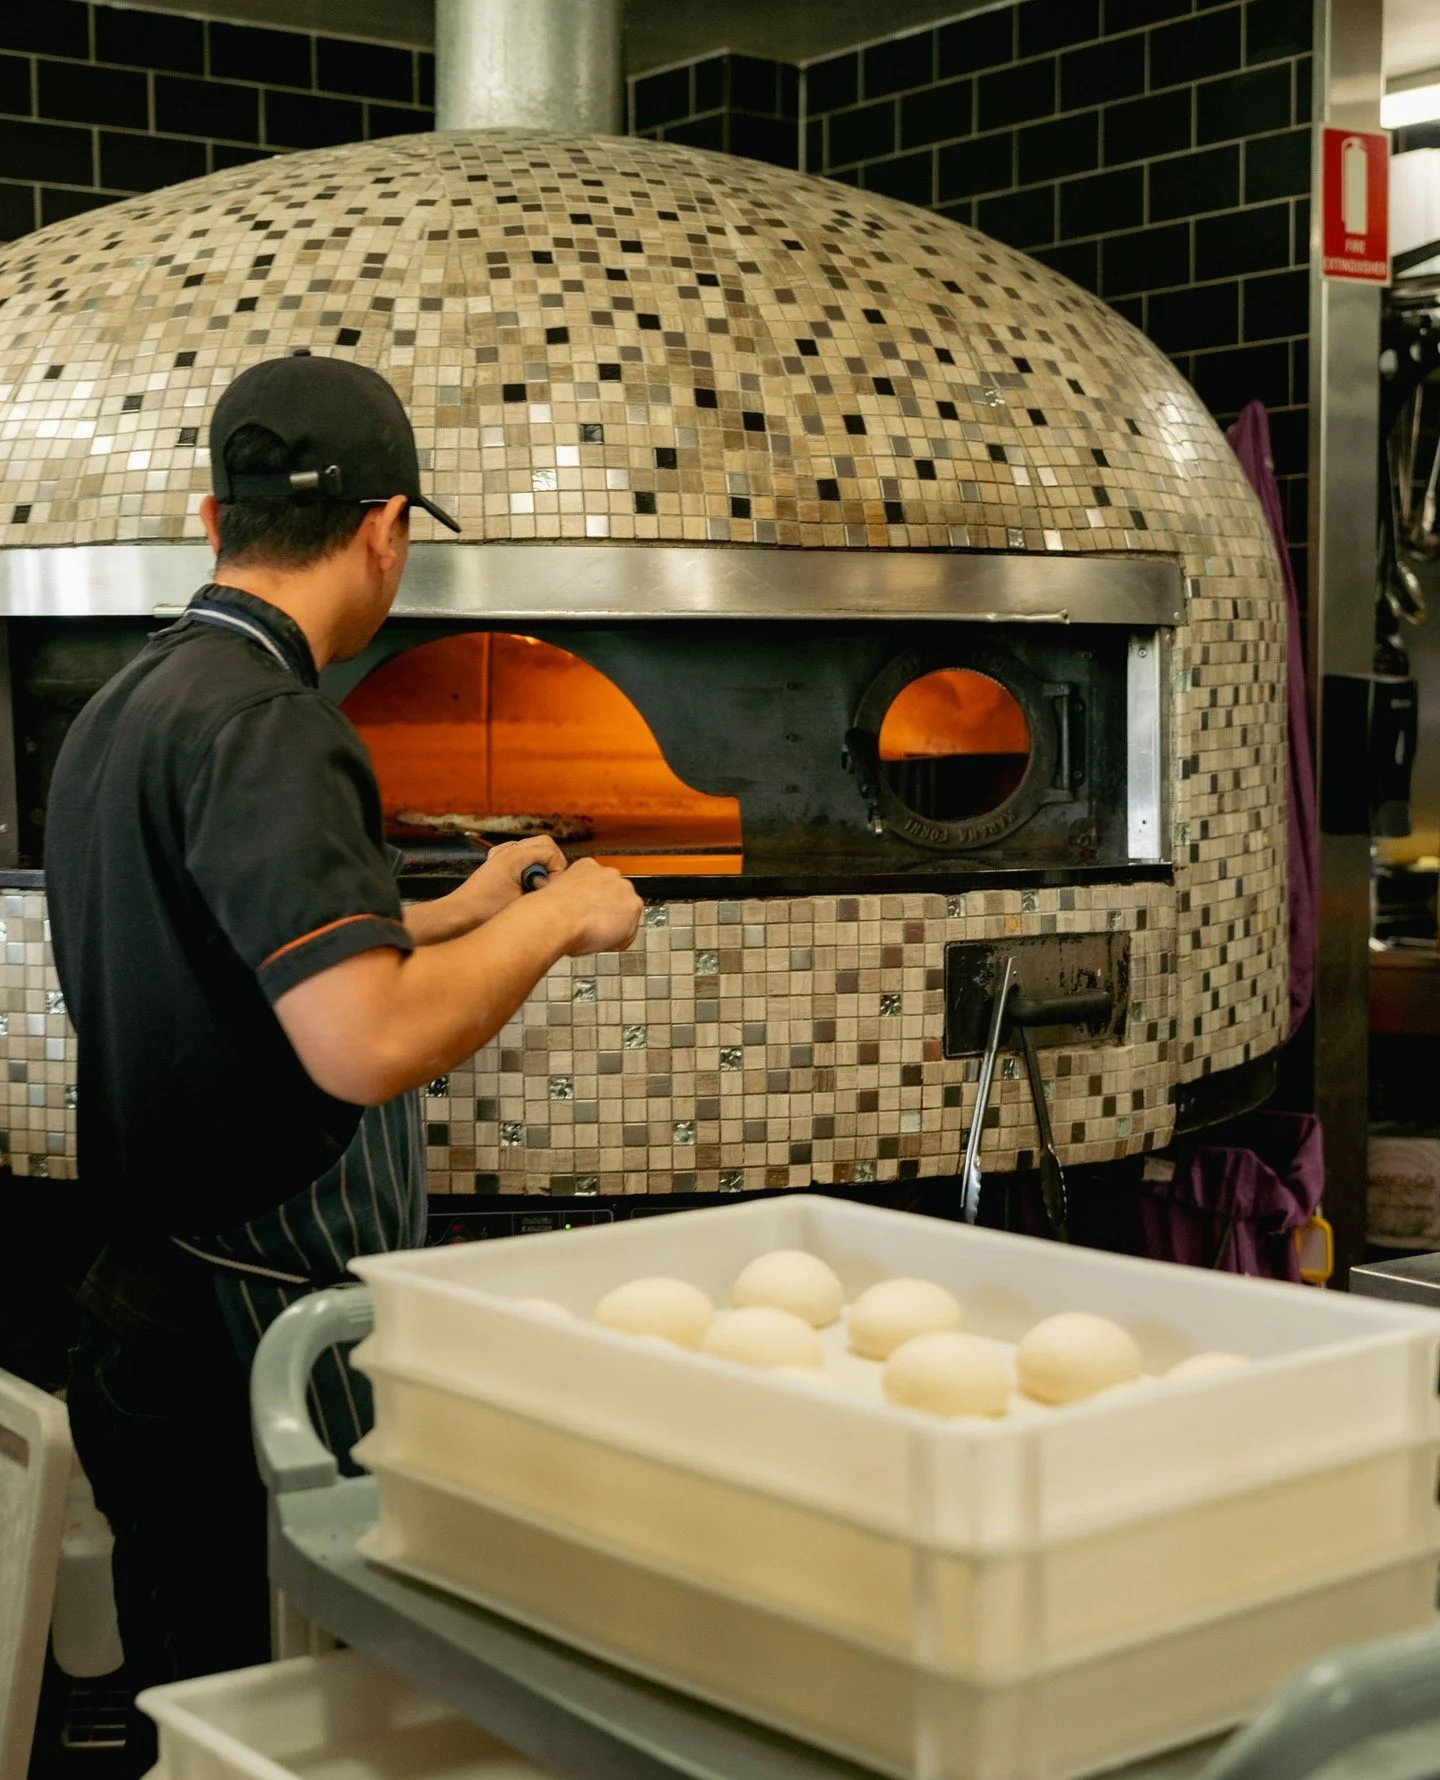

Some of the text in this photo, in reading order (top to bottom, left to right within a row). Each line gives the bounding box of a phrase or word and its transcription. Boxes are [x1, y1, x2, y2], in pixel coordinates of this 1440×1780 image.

[1345, 239, 1366, 255] FIRE
[1324, 256, 1386, 276] EXTINGUISHER
[904, 819, 949, 843] FORNI
